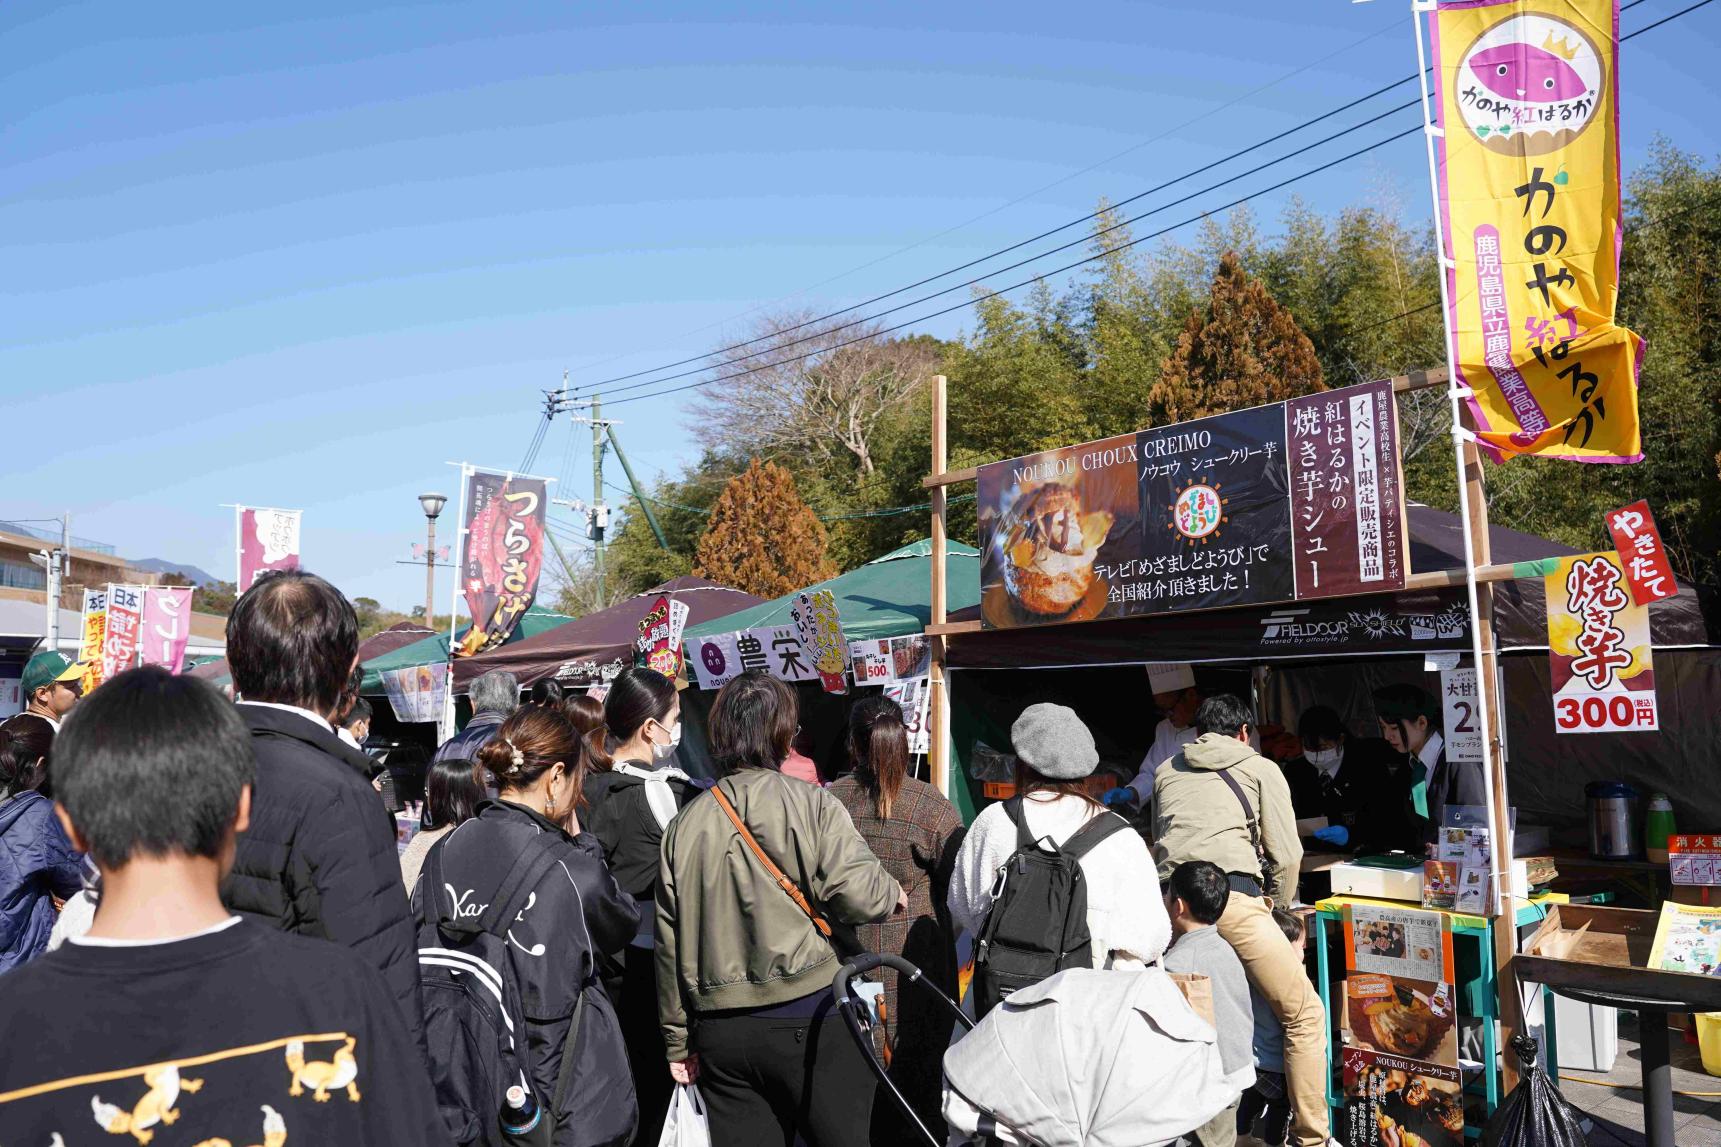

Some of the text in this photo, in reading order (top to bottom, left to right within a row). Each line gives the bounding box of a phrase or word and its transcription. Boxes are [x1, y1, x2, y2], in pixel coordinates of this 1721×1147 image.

[1013, 430, 1211, 485] NOUKOU CHOUX CREIMO
[1140, 441, 1277, 481] ノウコウ シュークリー芋
[1325, 400, 1350, 510] 紅はるかの
[1293, 406, 1328, 588] 焼き芋シュー
[1355, 399, 1380, 577] イベント限定販売商品
[1094, 544, 1269, 581] テレビ「めざましどようび」で
[1613, 510, 1666, 597] やきたて
[1260, 635, 1292, 645] Powered
[1294, 636, 1304, 645] by
[1280, 620, 1349, 638] FIELDOOR
[1568, 558, 1631, 690] 焼き芋
[1376, 1056, 1458, 1080] NOUKOU シュークリー芋
